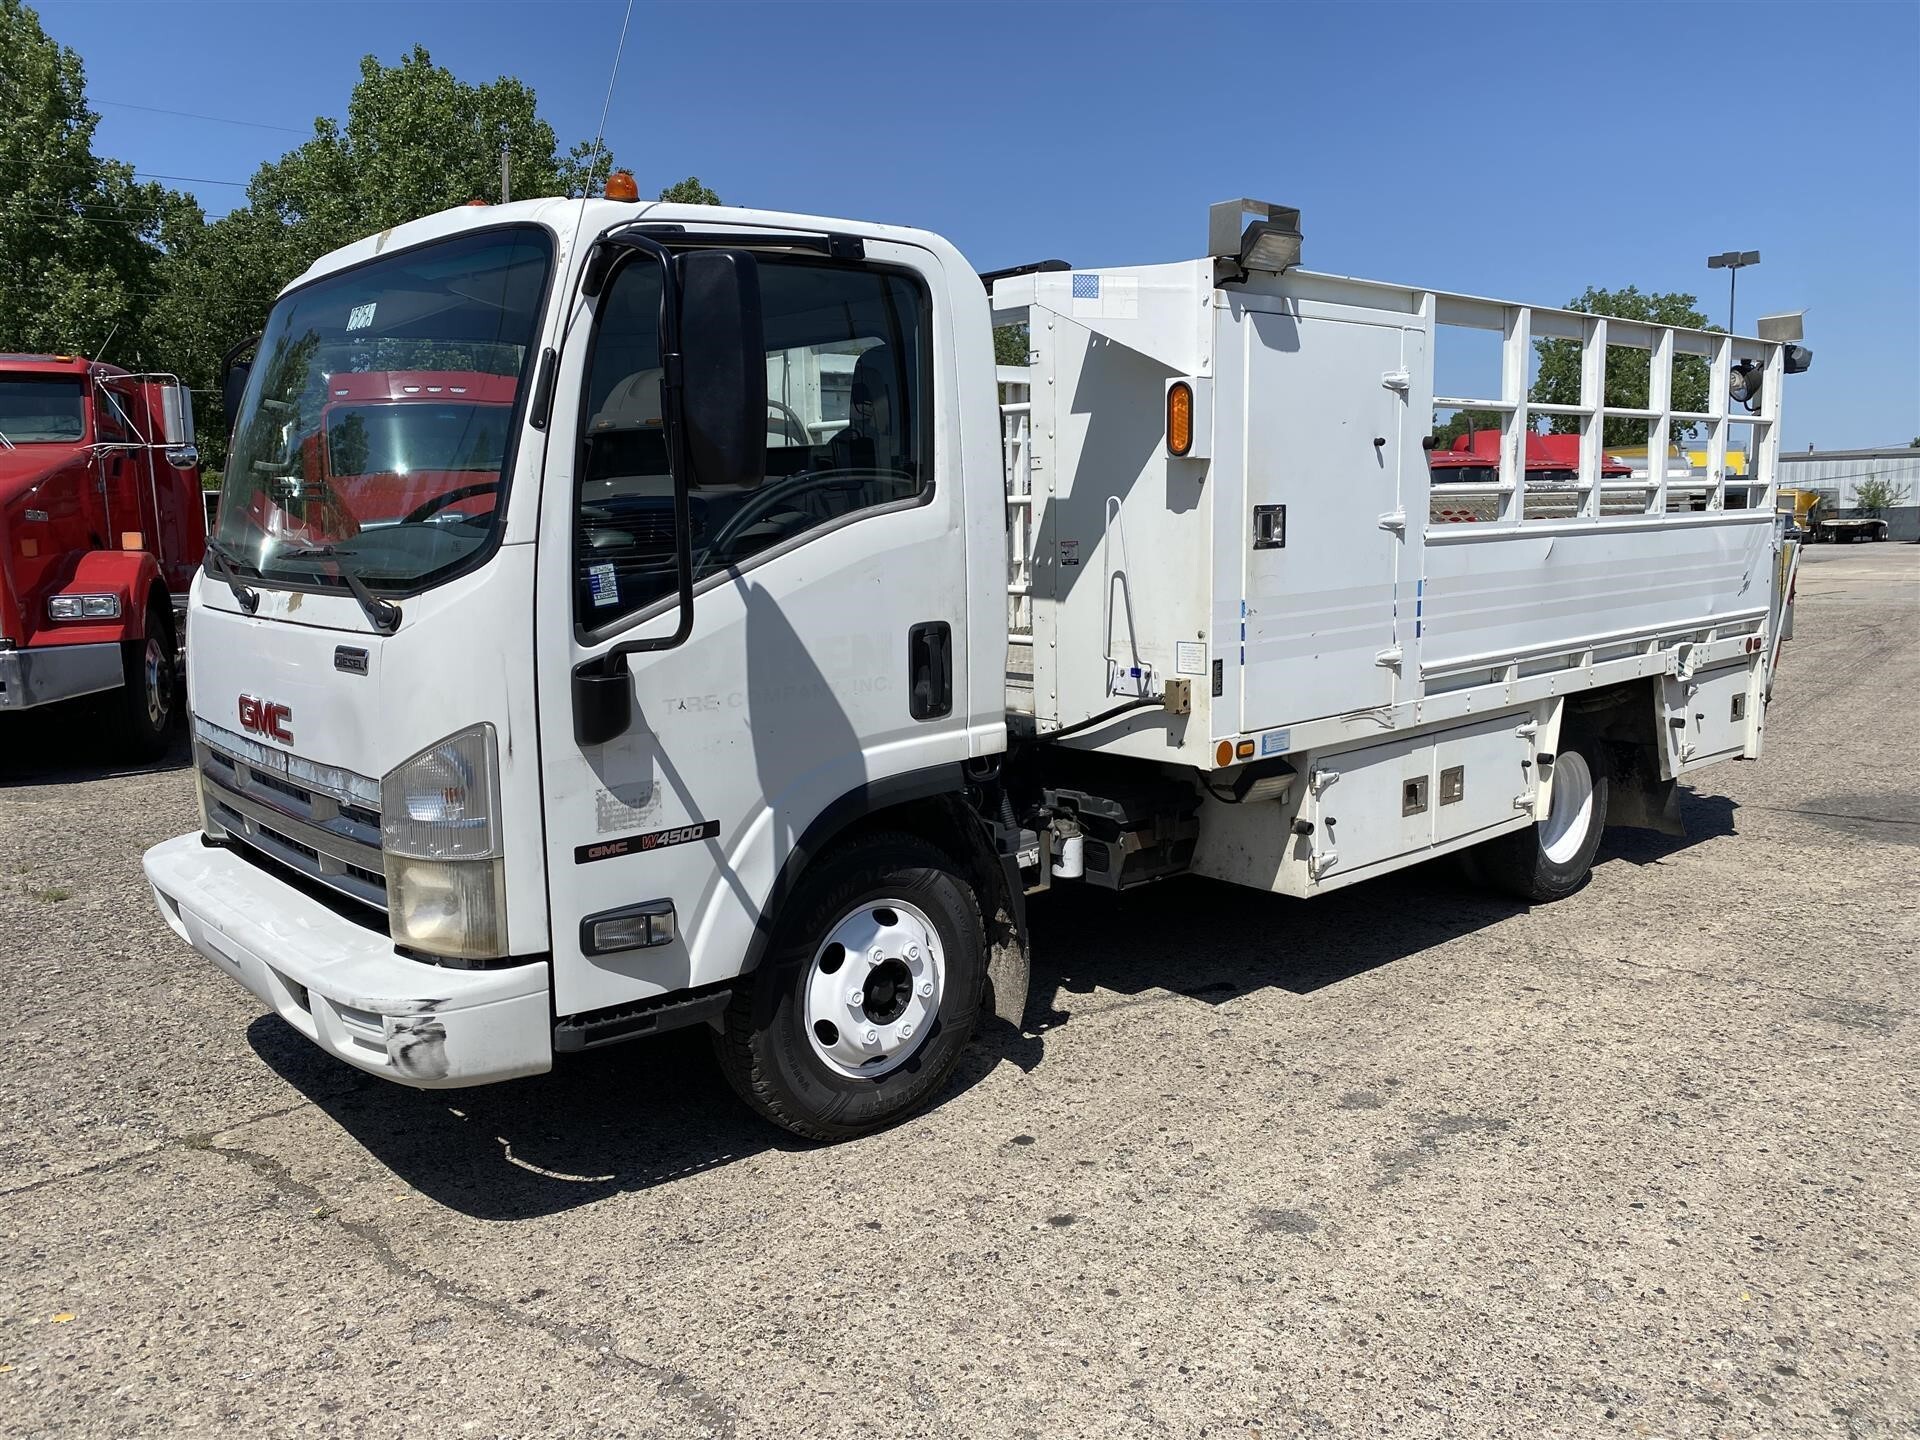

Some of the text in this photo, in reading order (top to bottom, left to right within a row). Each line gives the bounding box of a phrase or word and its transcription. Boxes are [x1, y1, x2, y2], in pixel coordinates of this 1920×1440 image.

[335, 653, 366, 672] DIESEL
[239, 693, 294, 746] GMC
[588, 825, 704, 858] GMC W4500
